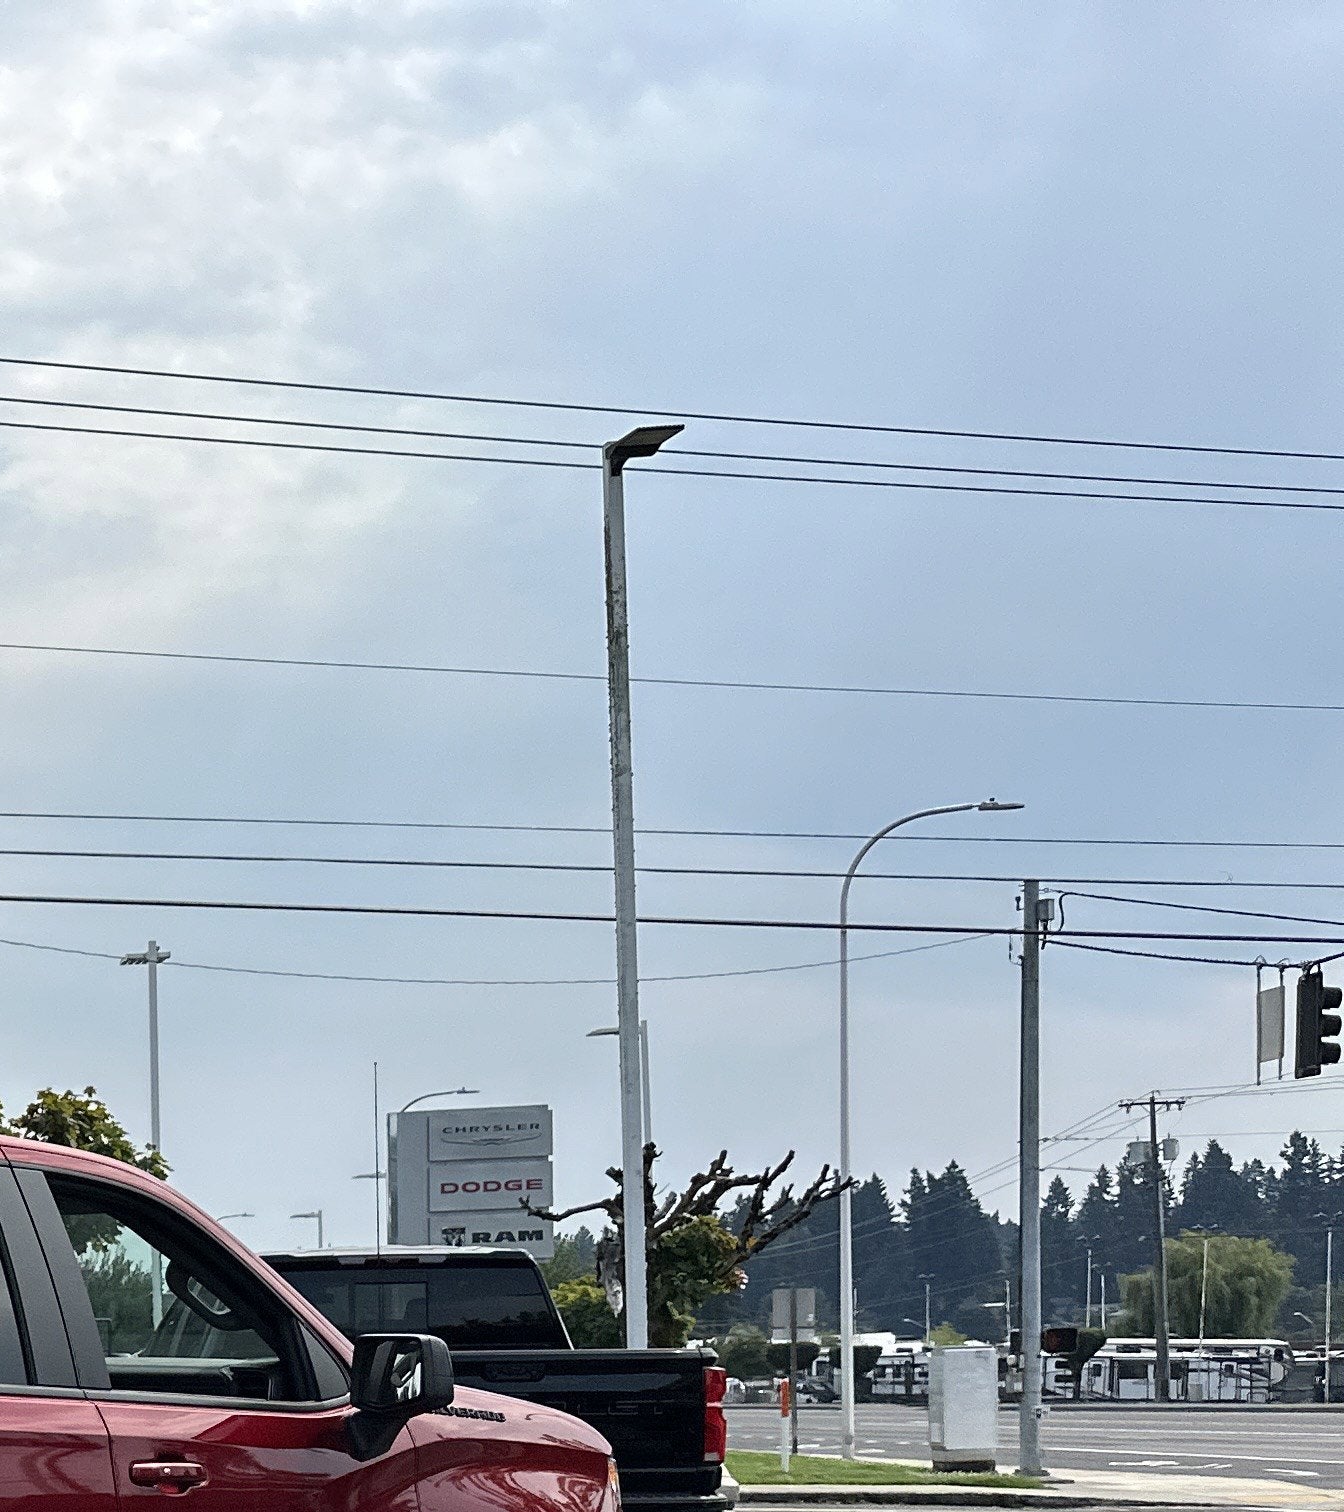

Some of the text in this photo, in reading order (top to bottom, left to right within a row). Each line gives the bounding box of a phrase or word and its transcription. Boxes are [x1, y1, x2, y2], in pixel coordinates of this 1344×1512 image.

[442, 1123, 540, 1134] CHRYSLER
[440, 1179, 543, 1194] DODGE
[471, 1229, 544, 1243] RAM
